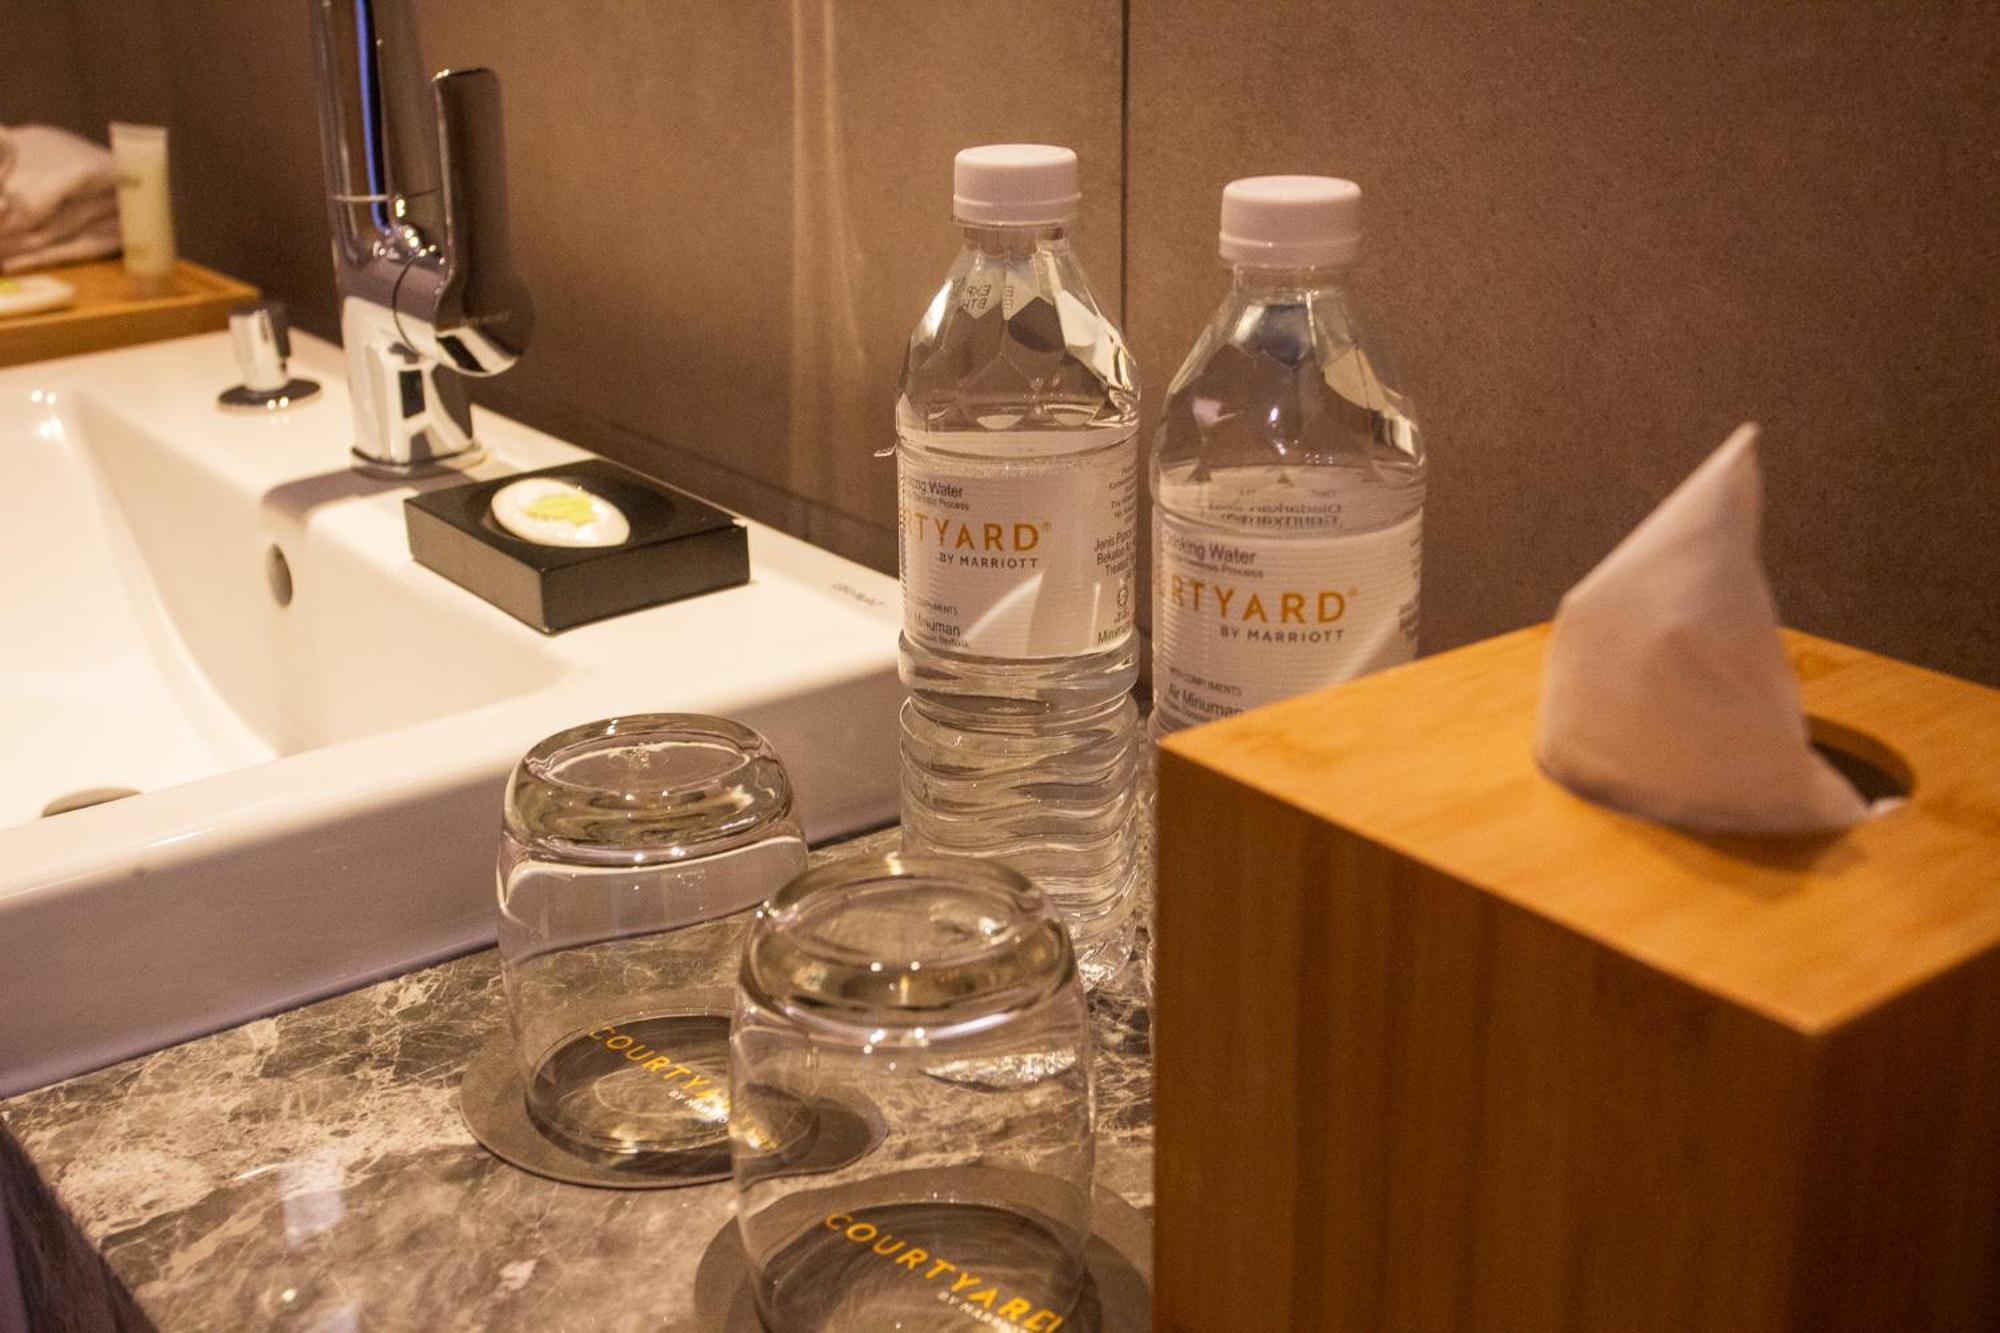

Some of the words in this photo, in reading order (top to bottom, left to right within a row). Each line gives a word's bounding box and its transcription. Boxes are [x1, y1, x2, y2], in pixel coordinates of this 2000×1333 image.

[928, 480, 963, 499] Water
[908, 512, 1039, 552] TYARD
[939, 552, 954, 565] BY
[959, 555, 1040, 569] MARRIOTT
[1208, 543, 1257, 565] Water
[1220, 625, 1239, 638] BY
[1247, 628, 1345, 644] MARRIOTT
[824, 1213, 1064, 1333] COURTYARD
